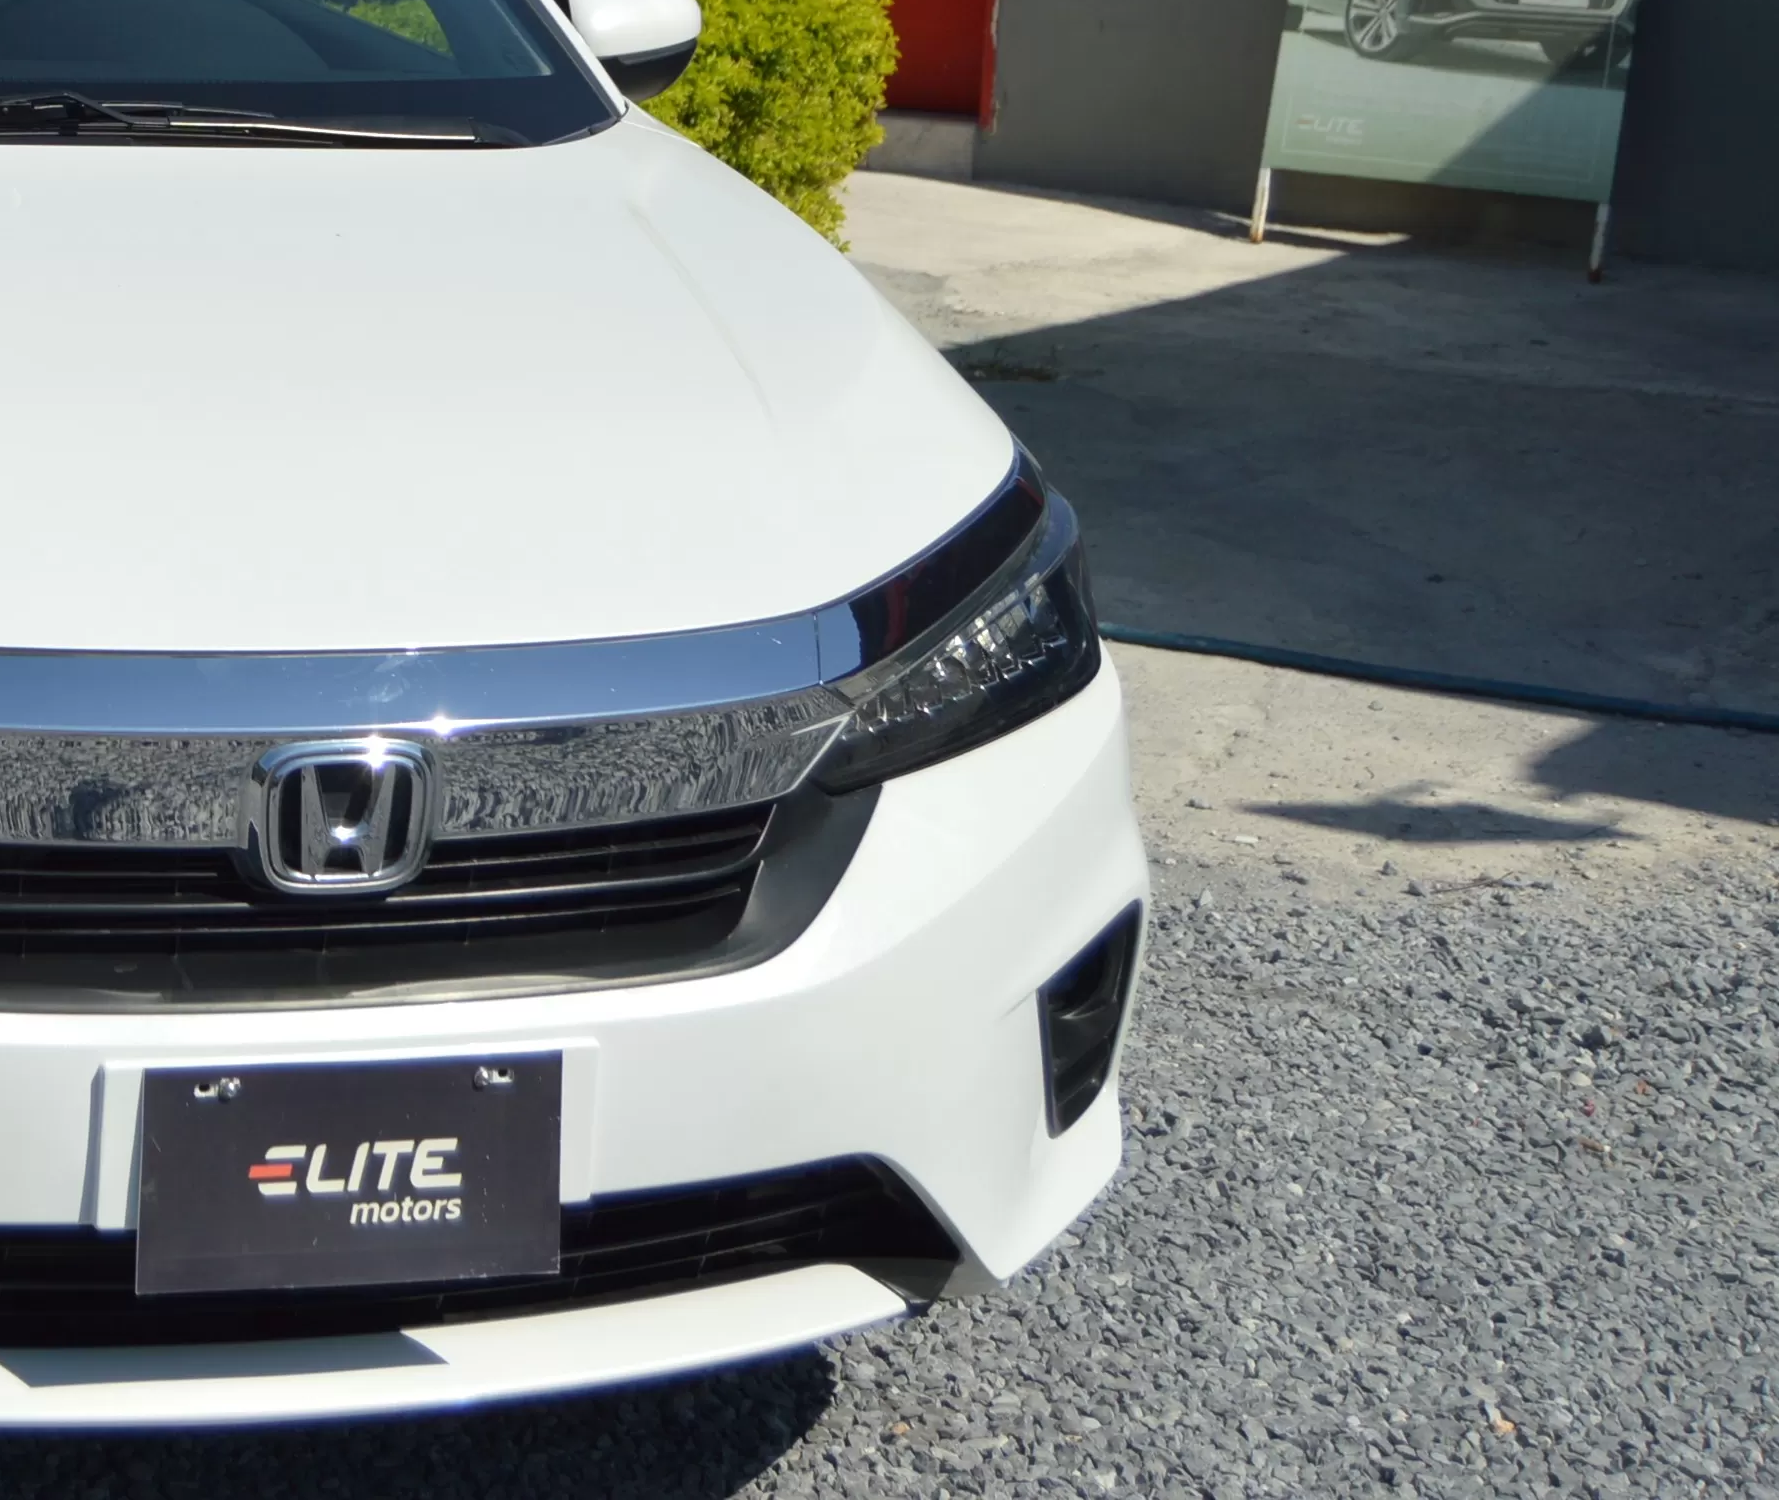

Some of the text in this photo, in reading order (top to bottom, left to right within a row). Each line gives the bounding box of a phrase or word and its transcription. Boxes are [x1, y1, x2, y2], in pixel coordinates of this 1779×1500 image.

[1294, 113, 1365, 137] ELITE
[248, 1137, 463, 1196] ELITE
[349, 1193, 462, 1226] motors
